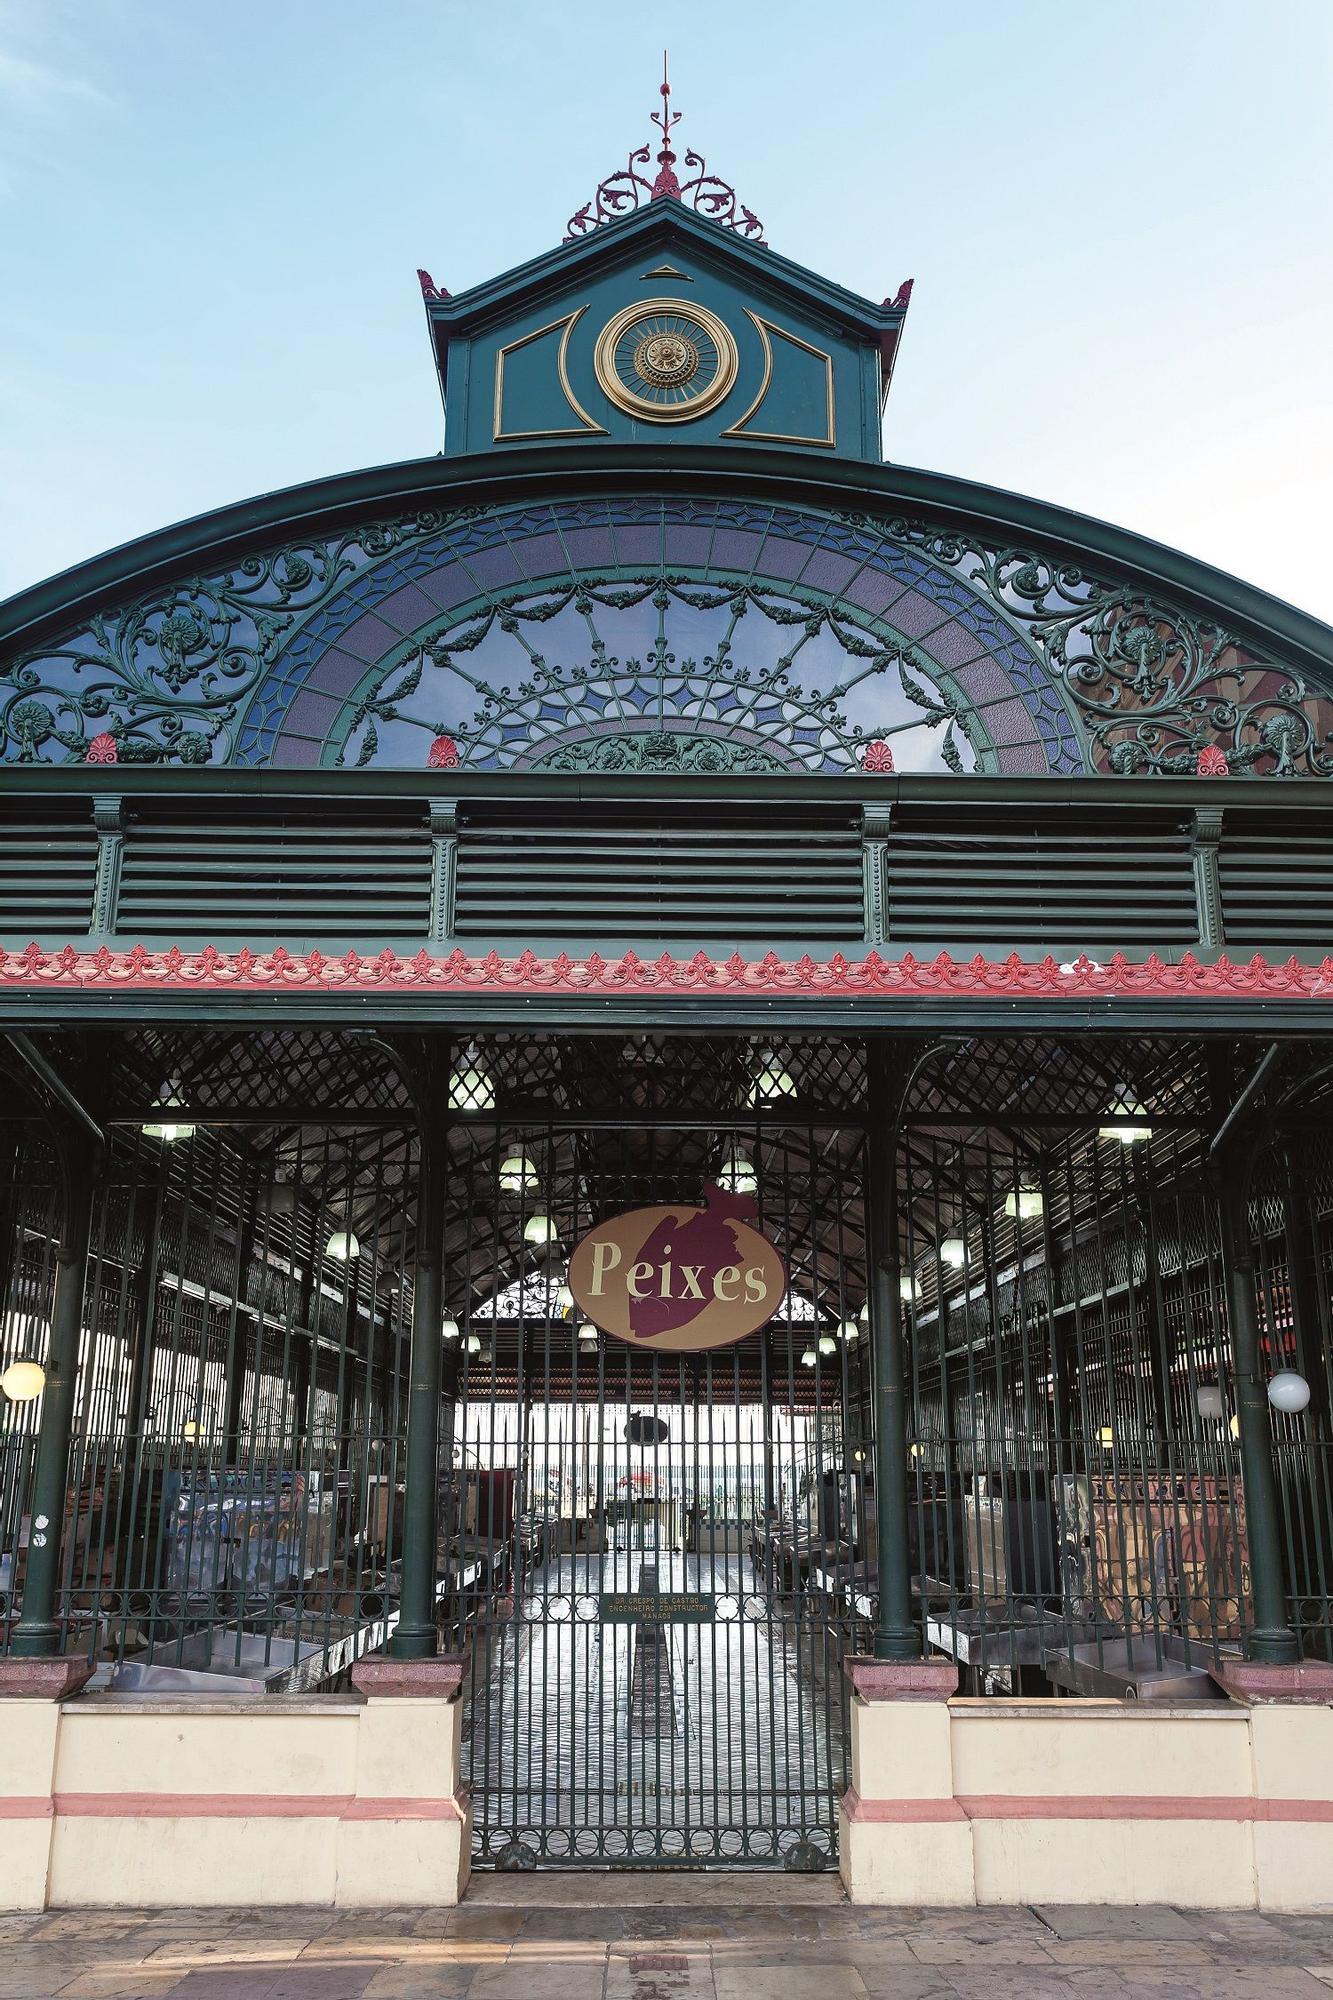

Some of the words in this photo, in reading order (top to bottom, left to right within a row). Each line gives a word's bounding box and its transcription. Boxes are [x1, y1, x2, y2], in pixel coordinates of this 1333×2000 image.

[587, 1242, 768, 1305] Peixes
[628, 1597, 655, 1605] CRESPO
[660, 1597, 669, 1605] DE
[659, 1604, 709, 1612] CONSTRUCTOR
